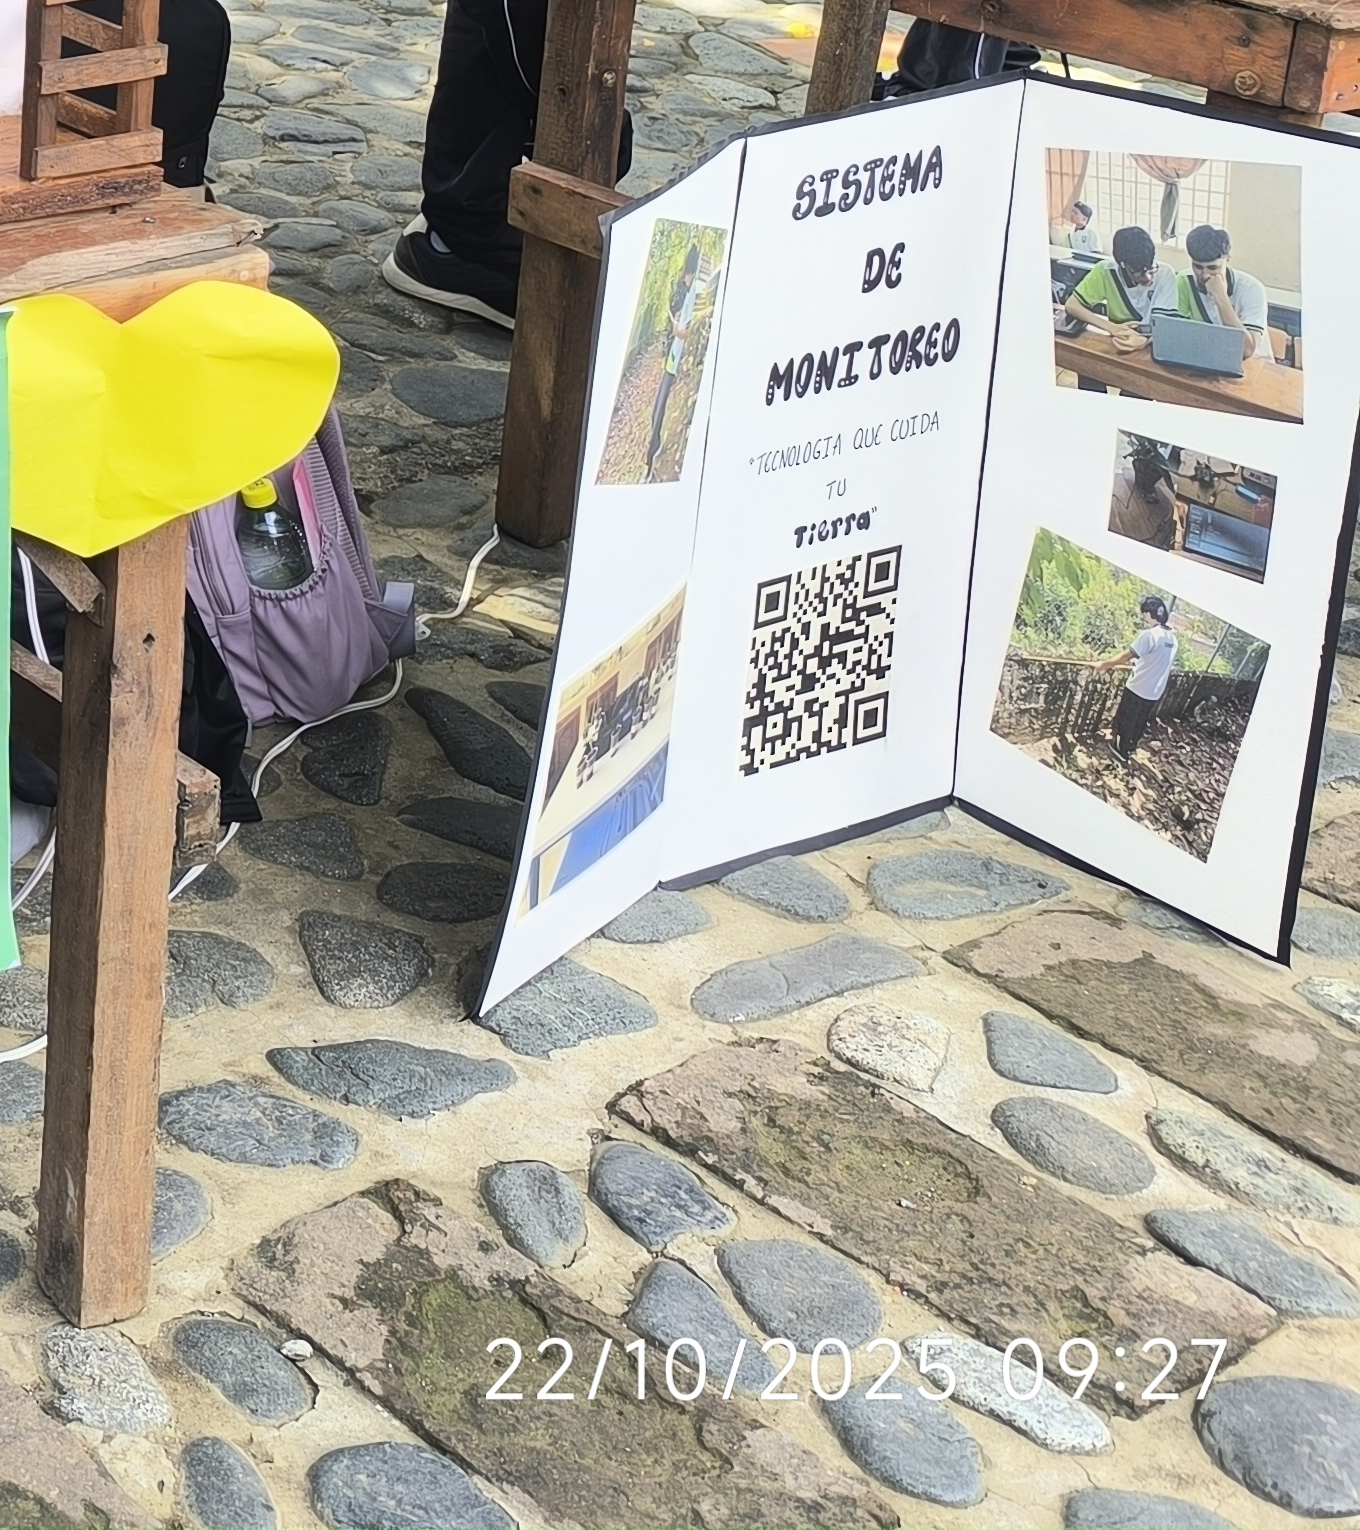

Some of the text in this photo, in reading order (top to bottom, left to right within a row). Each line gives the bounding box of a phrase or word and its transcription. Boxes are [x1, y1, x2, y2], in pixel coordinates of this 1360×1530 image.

[791, 145, 943, 221] SISTEMA
[861, 242, 905, 293] DE
[766, 318, 960, 406] MONITOREO
[853, 424, 883, 450] QUE
[890, 411, 940, 442] CUIDA
[826, 479, 847, 500] TU
